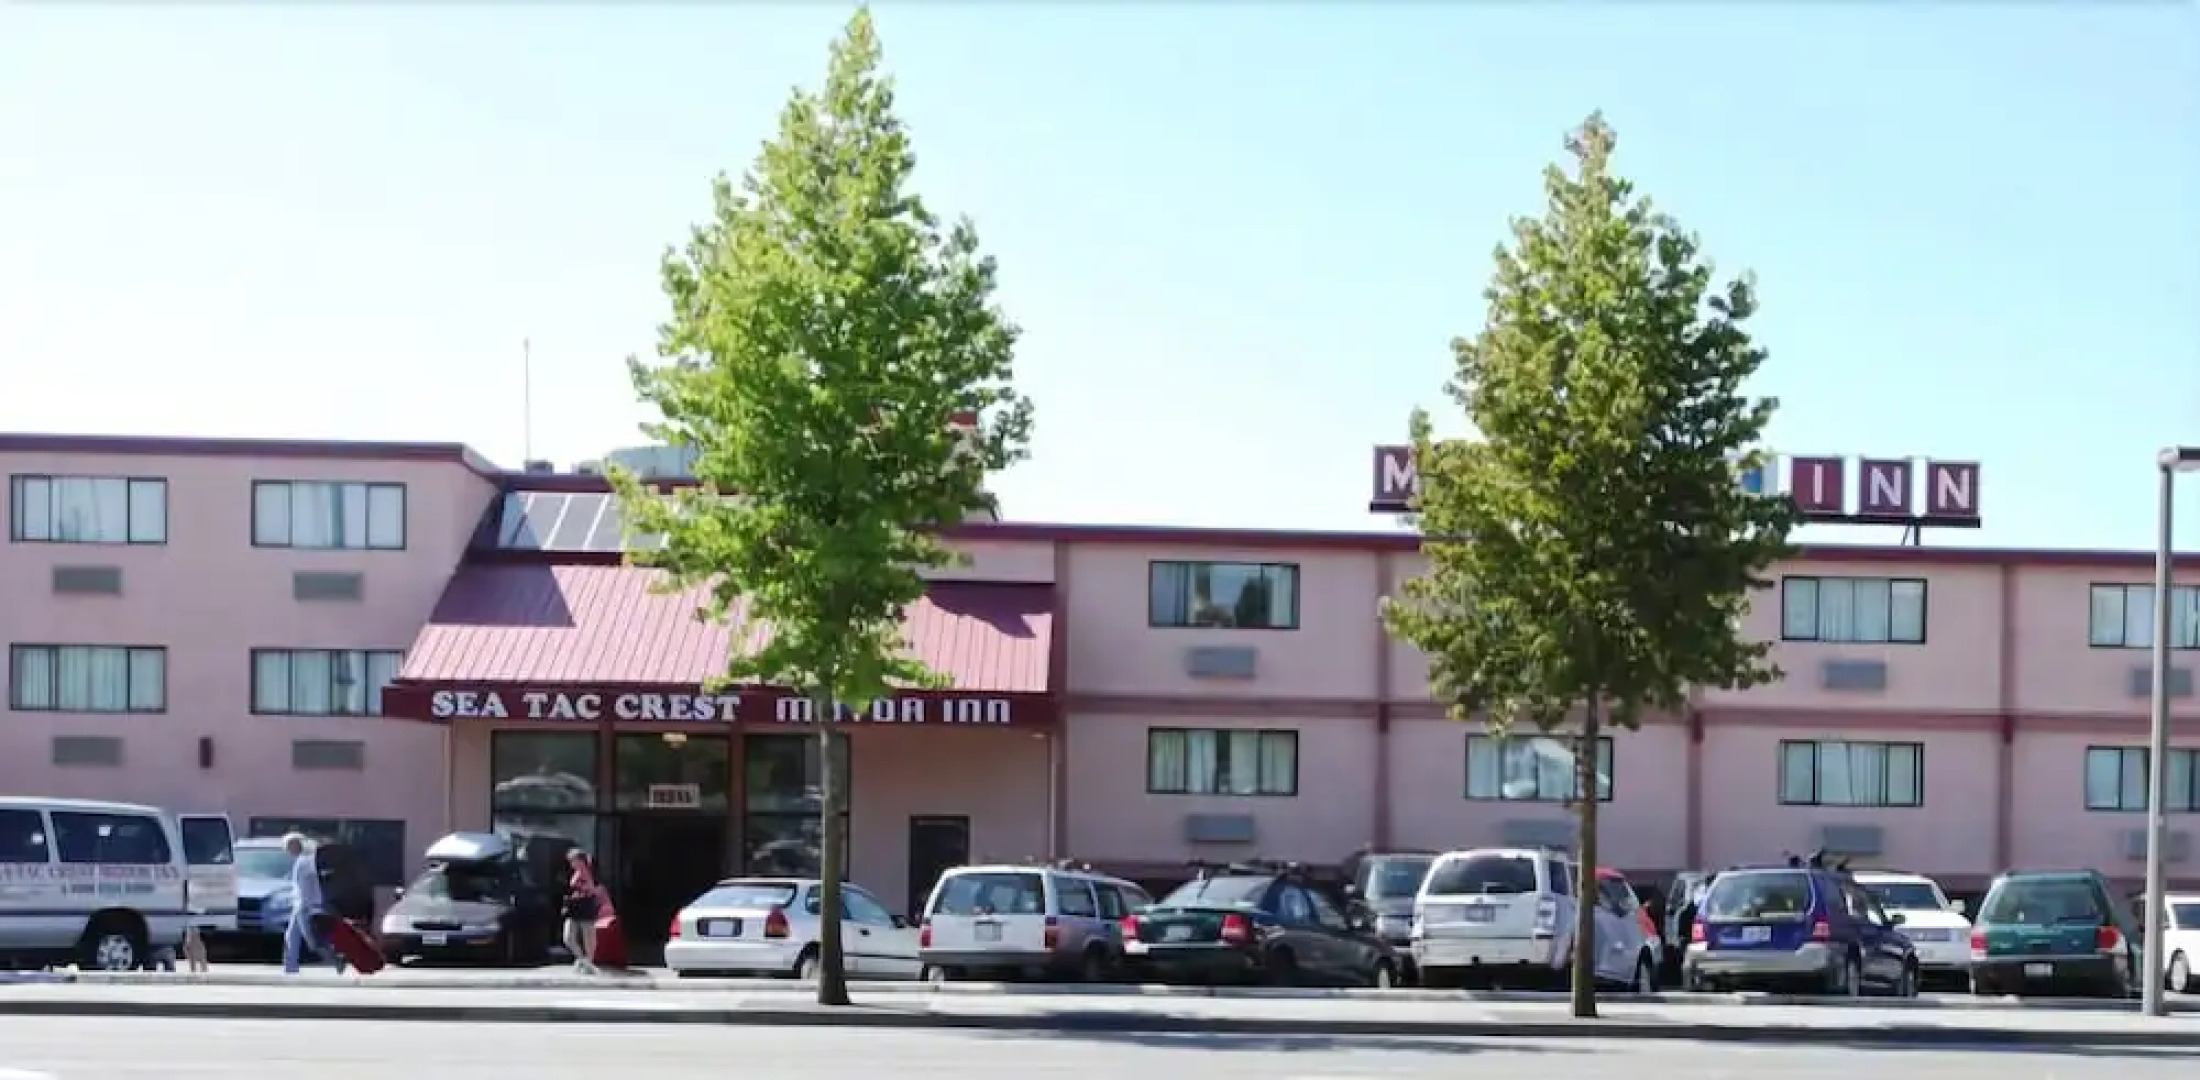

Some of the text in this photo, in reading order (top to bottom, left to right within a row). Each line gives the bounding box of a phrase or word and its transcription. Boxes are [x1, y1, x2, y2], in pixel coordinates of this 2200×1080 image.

[1813, 462, 1970, 510] INN
[431, 690, 1010, 722] SEA TAC CREST MOR INN
